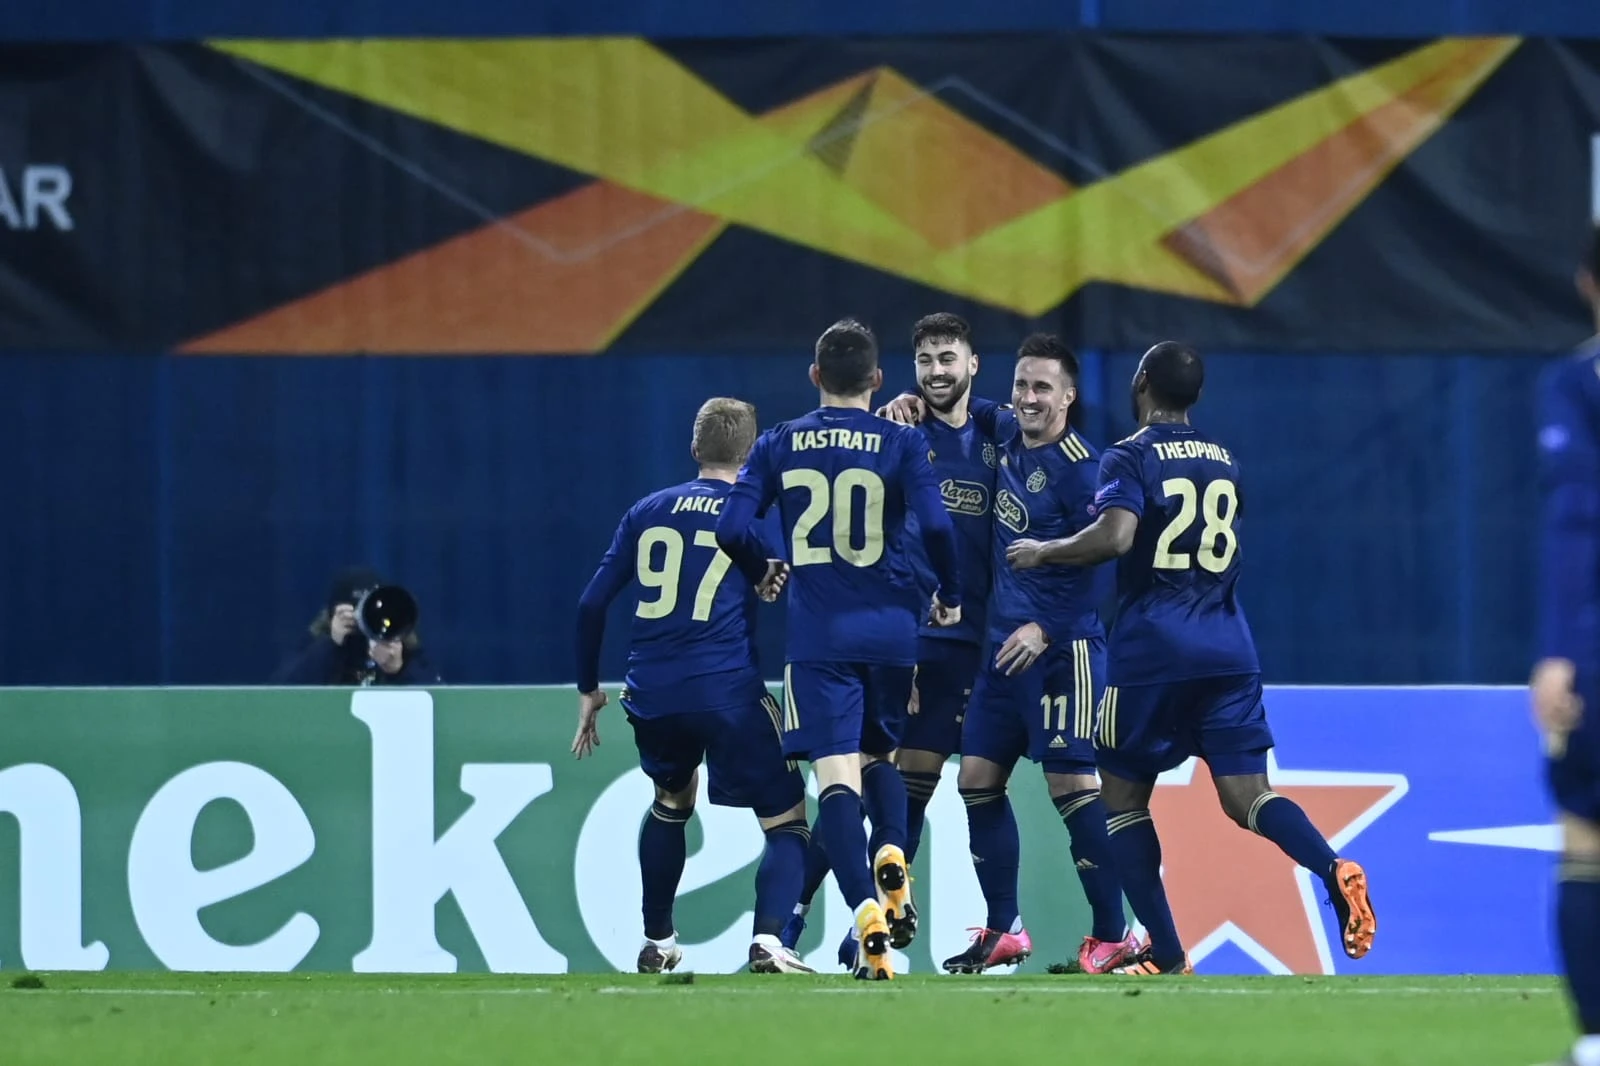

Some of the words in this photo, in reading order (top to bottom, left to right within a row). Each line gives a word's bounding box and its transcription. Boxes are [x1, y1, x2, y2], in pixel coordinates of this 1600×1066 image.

[791, 428, 882, 453] KASTRATI
[1152, 440, 1232, 466] THEOPHILE
[781, 468, 885, 568] 20
[1152, 477, 1239, 573] 28
[635, 526, 733, 622] 97
[1040, 694, 1067, 731] 11
